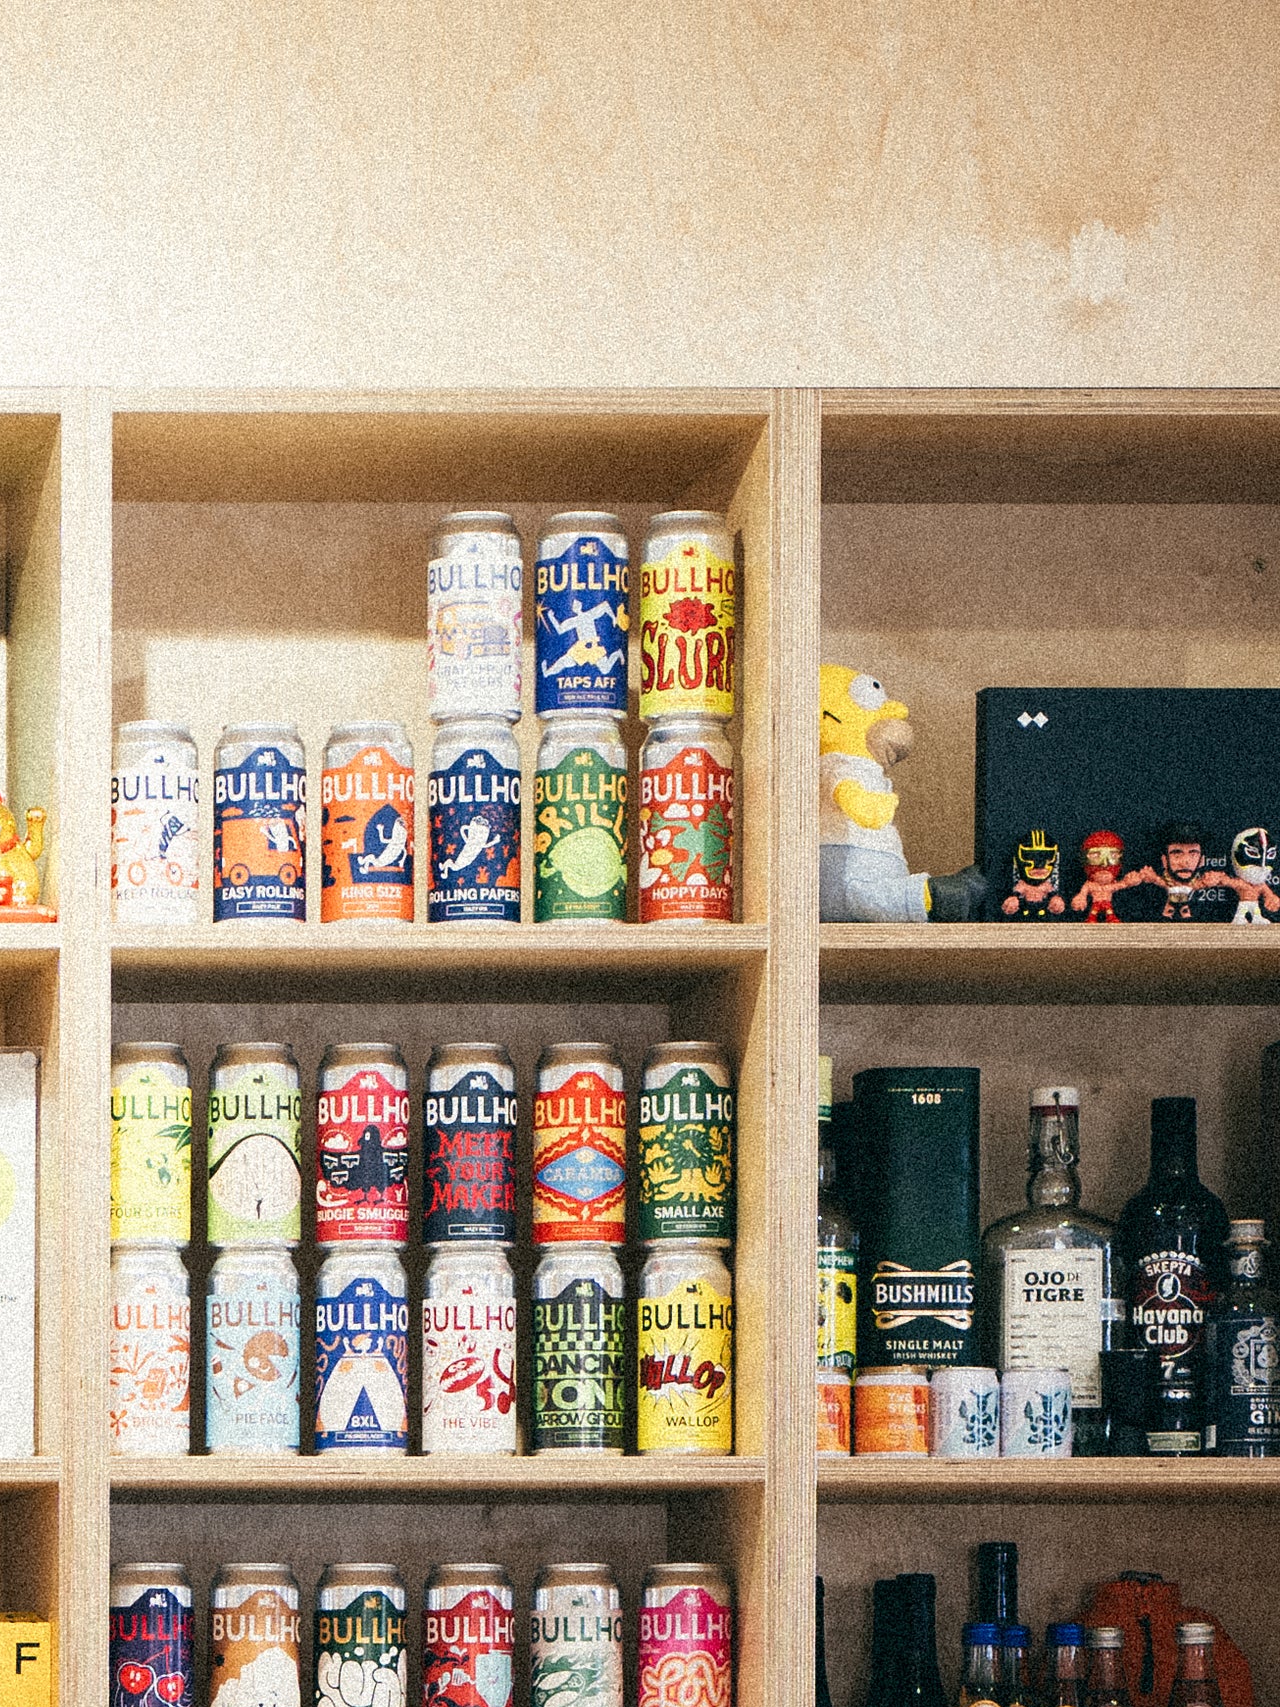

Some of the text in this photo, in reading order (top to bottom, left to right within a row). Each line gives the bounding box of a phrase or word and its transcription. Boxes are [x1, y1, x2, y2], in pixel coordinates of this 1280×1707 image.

[557, 676, 617, 690] TAPS AFF
[222, 886, 253, 901] EASY
[341, 886, 403, 899] KING SIZE
[653, 886, 728, 901] HOPPY DAYS
[912, 1093, 942, 1105] 1608
[430, 1130, 513, 1161] MEET
[442, 1161, 504, 1181] YOUR
[654, 1206, 725, 1218] SMALL AXE
[1144, 1260, 1192, 1278] SKEPTA
[1024, 1271, 1064, 1286] OJO
[875, 1283, 974, 1305] BUSHMILLS
[1023, 1288, 1085, 1303] TIGRE
[1133, 1305, 1203, 1325] Havana
[1145, 1325, 1188, 1345] Club
[886, 1340, 964, 1350] SINGLE MALT
[552, 1379, 614, 1411] ON
[235, 1412, 290, 1425] PIE FACE
[443, 1418, 467, 1429] THE
[666, 1416, 720, 1428] WALLOP
[16, 1642, 40, 1674] F
